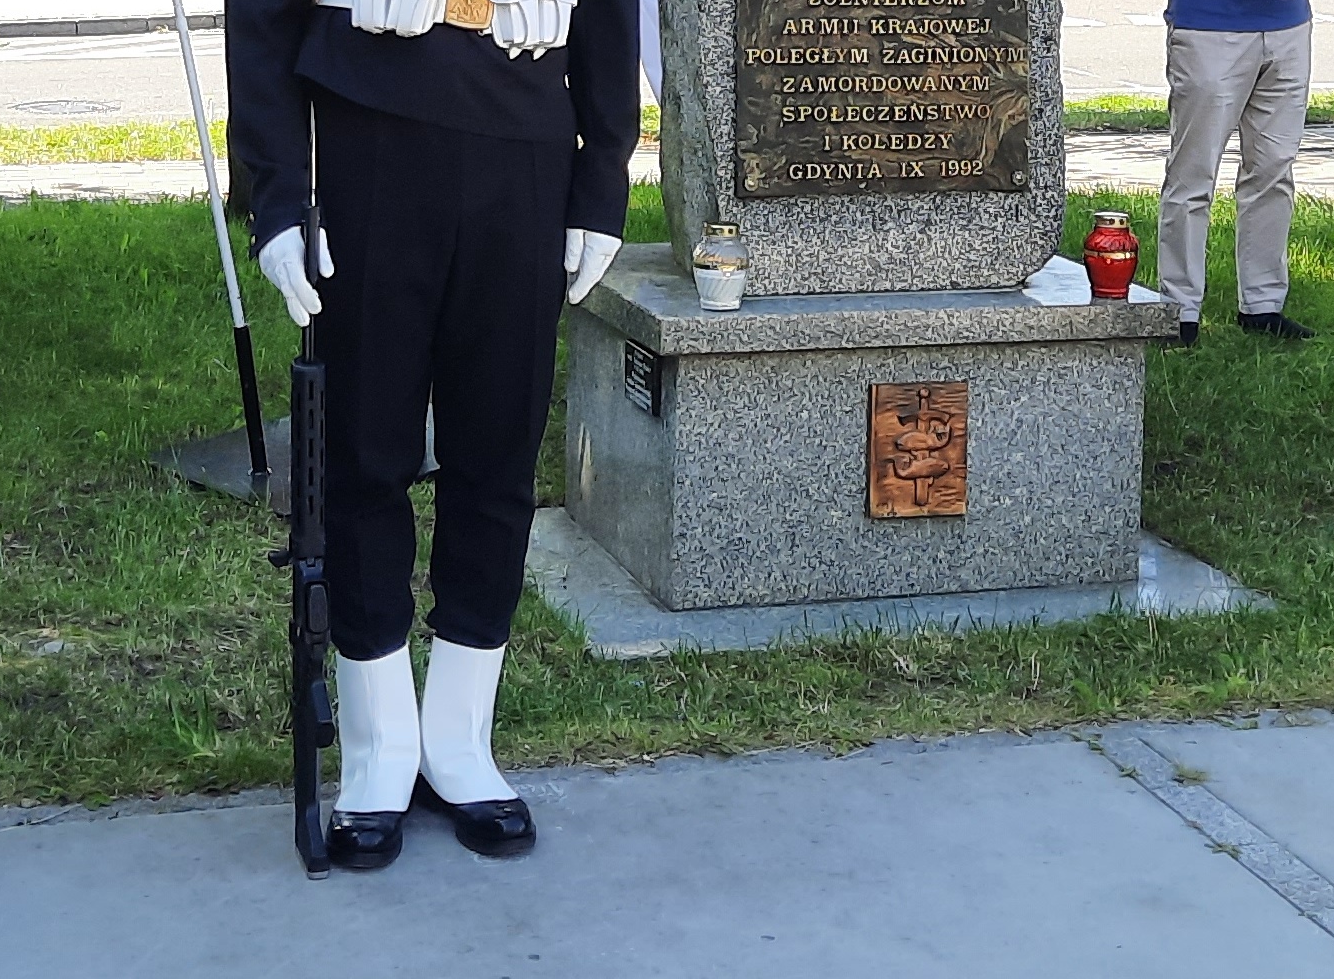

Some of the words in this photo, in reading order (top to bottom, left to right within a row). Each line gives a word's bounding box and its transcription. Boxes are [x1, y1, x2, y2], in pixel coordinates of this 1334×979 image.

[783, 19, 860, 34] ARMII
[870, 18, 991, 35] KRAJOWEJ
[745, 47, 869, 64] POLEGŁYM
[882, 47, 1026, 64] ZAGINIONYM
[782, 76, 990, 93] ZAMORDOWANYM
[782, 102, 991, 122] SPOŁECZEŃSTWO
[822, 135, 831, 151] I
[842, 134, 953, 151] KOLEDZY
[789, 161, 882, 180] GDYNIA
[900, 161, 924, 178] IX
[939, 160, 984, 176] 1992
